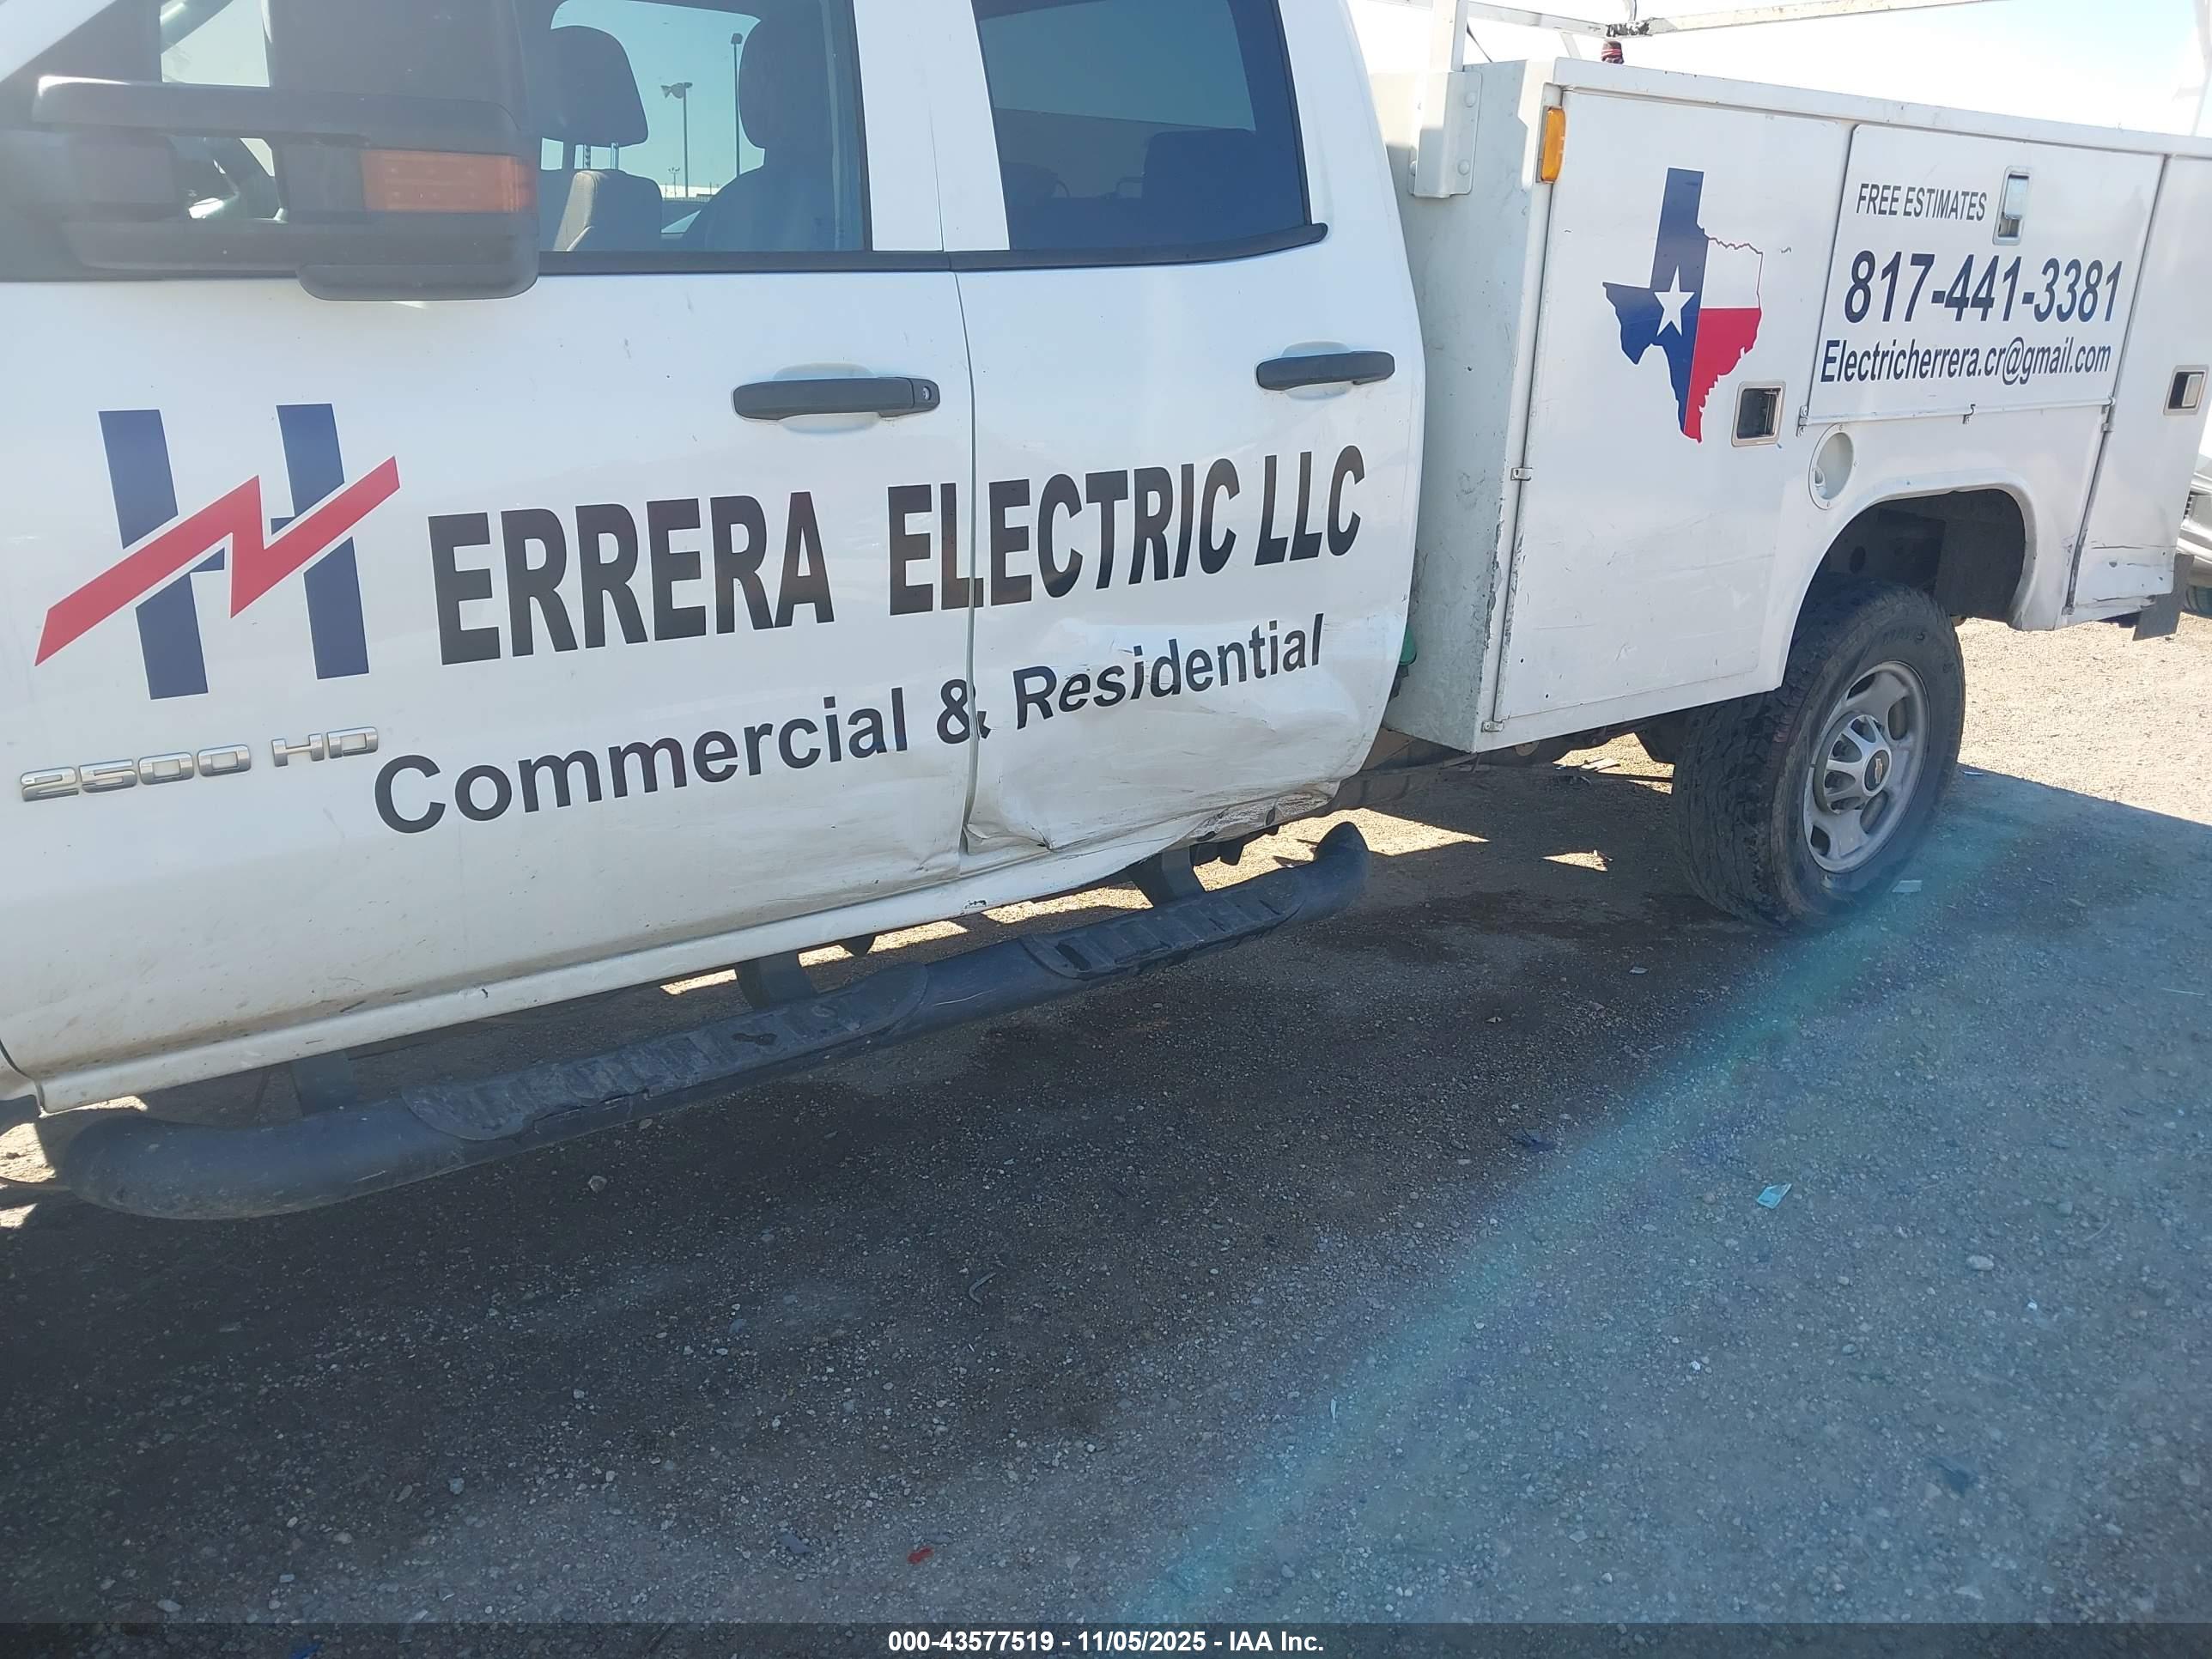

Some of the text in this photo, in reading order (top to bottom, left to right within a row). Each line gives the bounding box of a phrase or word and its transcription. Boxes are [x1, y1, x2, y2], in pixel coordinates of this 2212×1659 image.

[1856, 183, 1987, 222] FREE ESTIMATES
[1844, 250, 2123, 324] 817-441-3381
[1820, 336, 2112, 386] Electricherrera.cr@gmail.com
[888, 459, 1240, 616] ELECTRIC
[1255, 445, 1365, 566] LLC
[374, 613, 1324, 834] Commercial & Residential
[20, 726, 380, 803] 2500 HD
